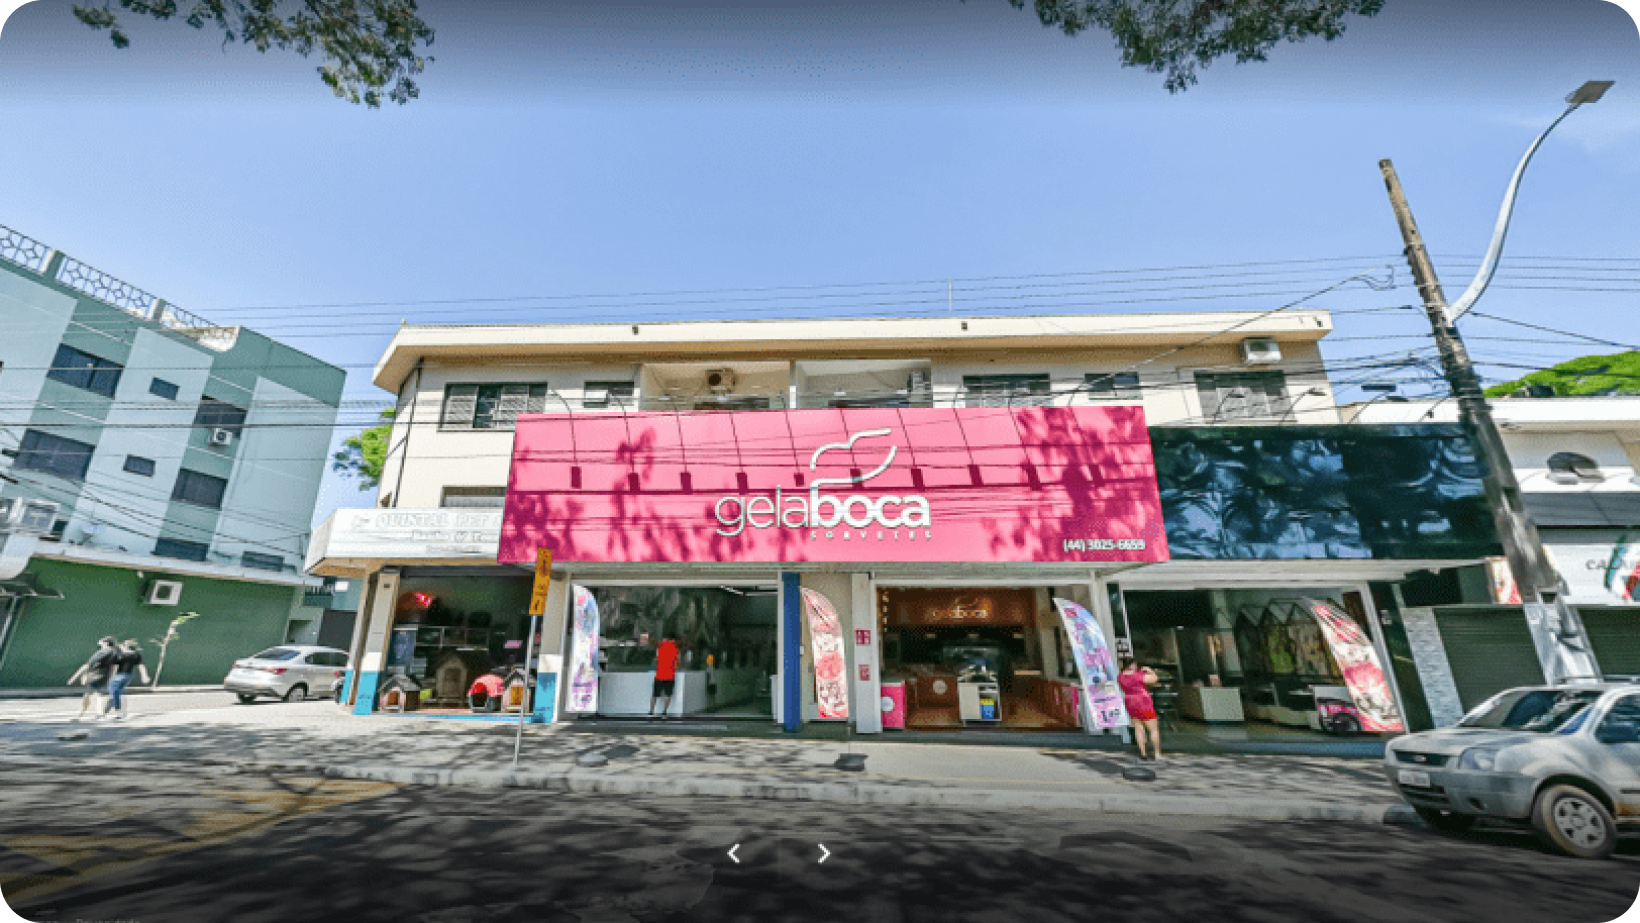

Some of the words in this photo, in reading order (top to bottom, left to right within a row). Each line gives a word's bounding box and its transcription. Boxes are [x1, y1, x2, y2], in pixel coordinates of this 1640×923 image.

[714, 479, 931, 536] gelaboca
[809, 531, 932, 541] SORVETES
[1063, 539, 1086, 553] (44)
